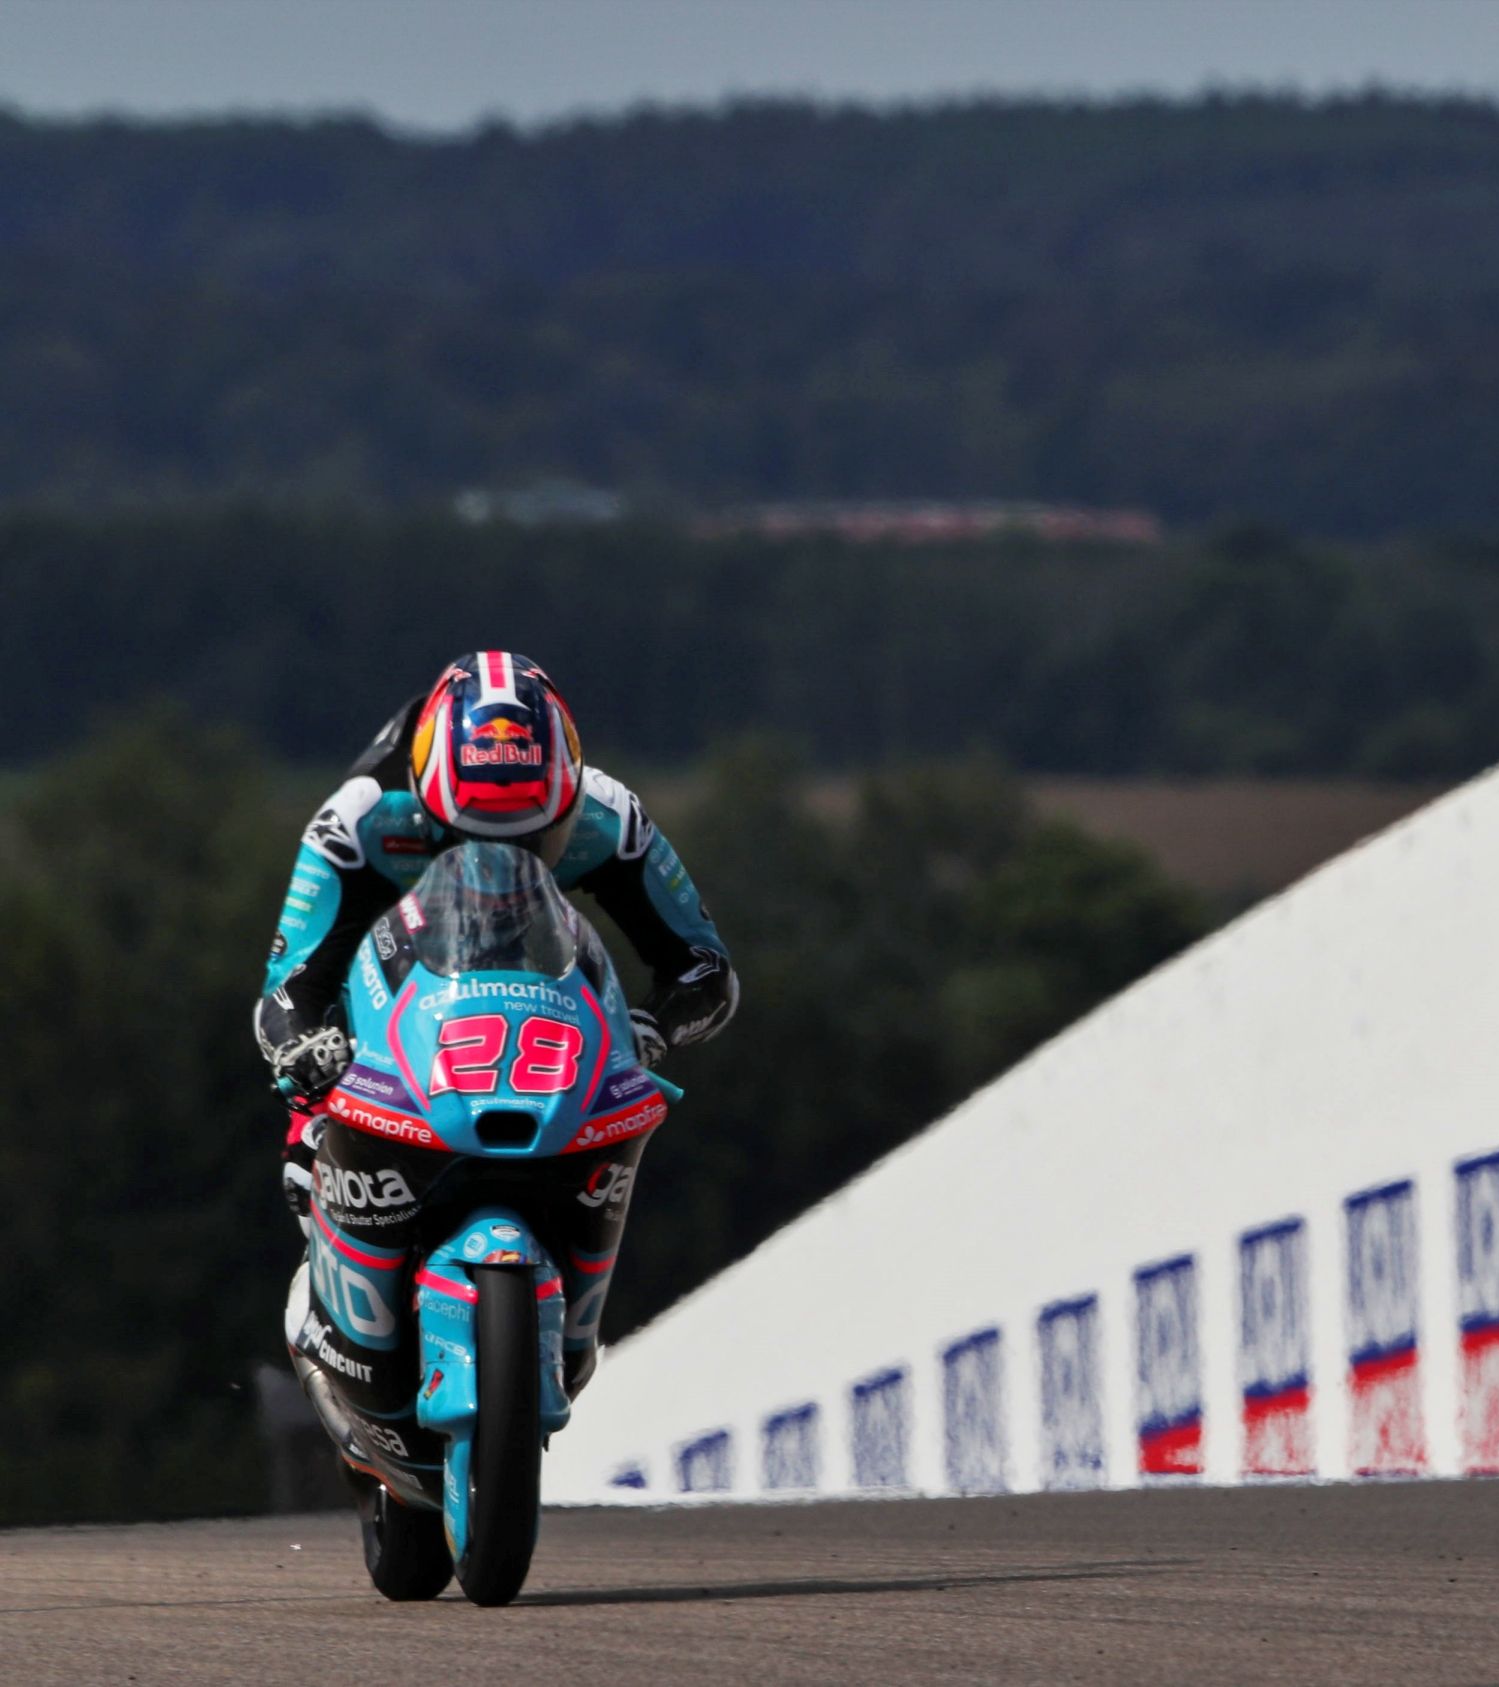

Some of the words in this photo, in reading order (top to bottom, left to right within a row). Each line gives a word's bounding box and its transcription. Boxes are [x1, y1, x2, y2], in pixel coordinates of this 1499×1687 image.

[460, 742, 503, 766] Red
[504, 743, 542, 766] Bull
[419, 978, 577, 1011] azulmarino
[504, 999, 538, 1012] new
[429, 1013, 584, 1096] 28
[353, 1108, 432, 1144] mapfre
[606, 1103, 667, 1138] mapfre
[319, 1341, 373, 1383] CIRCUIT
